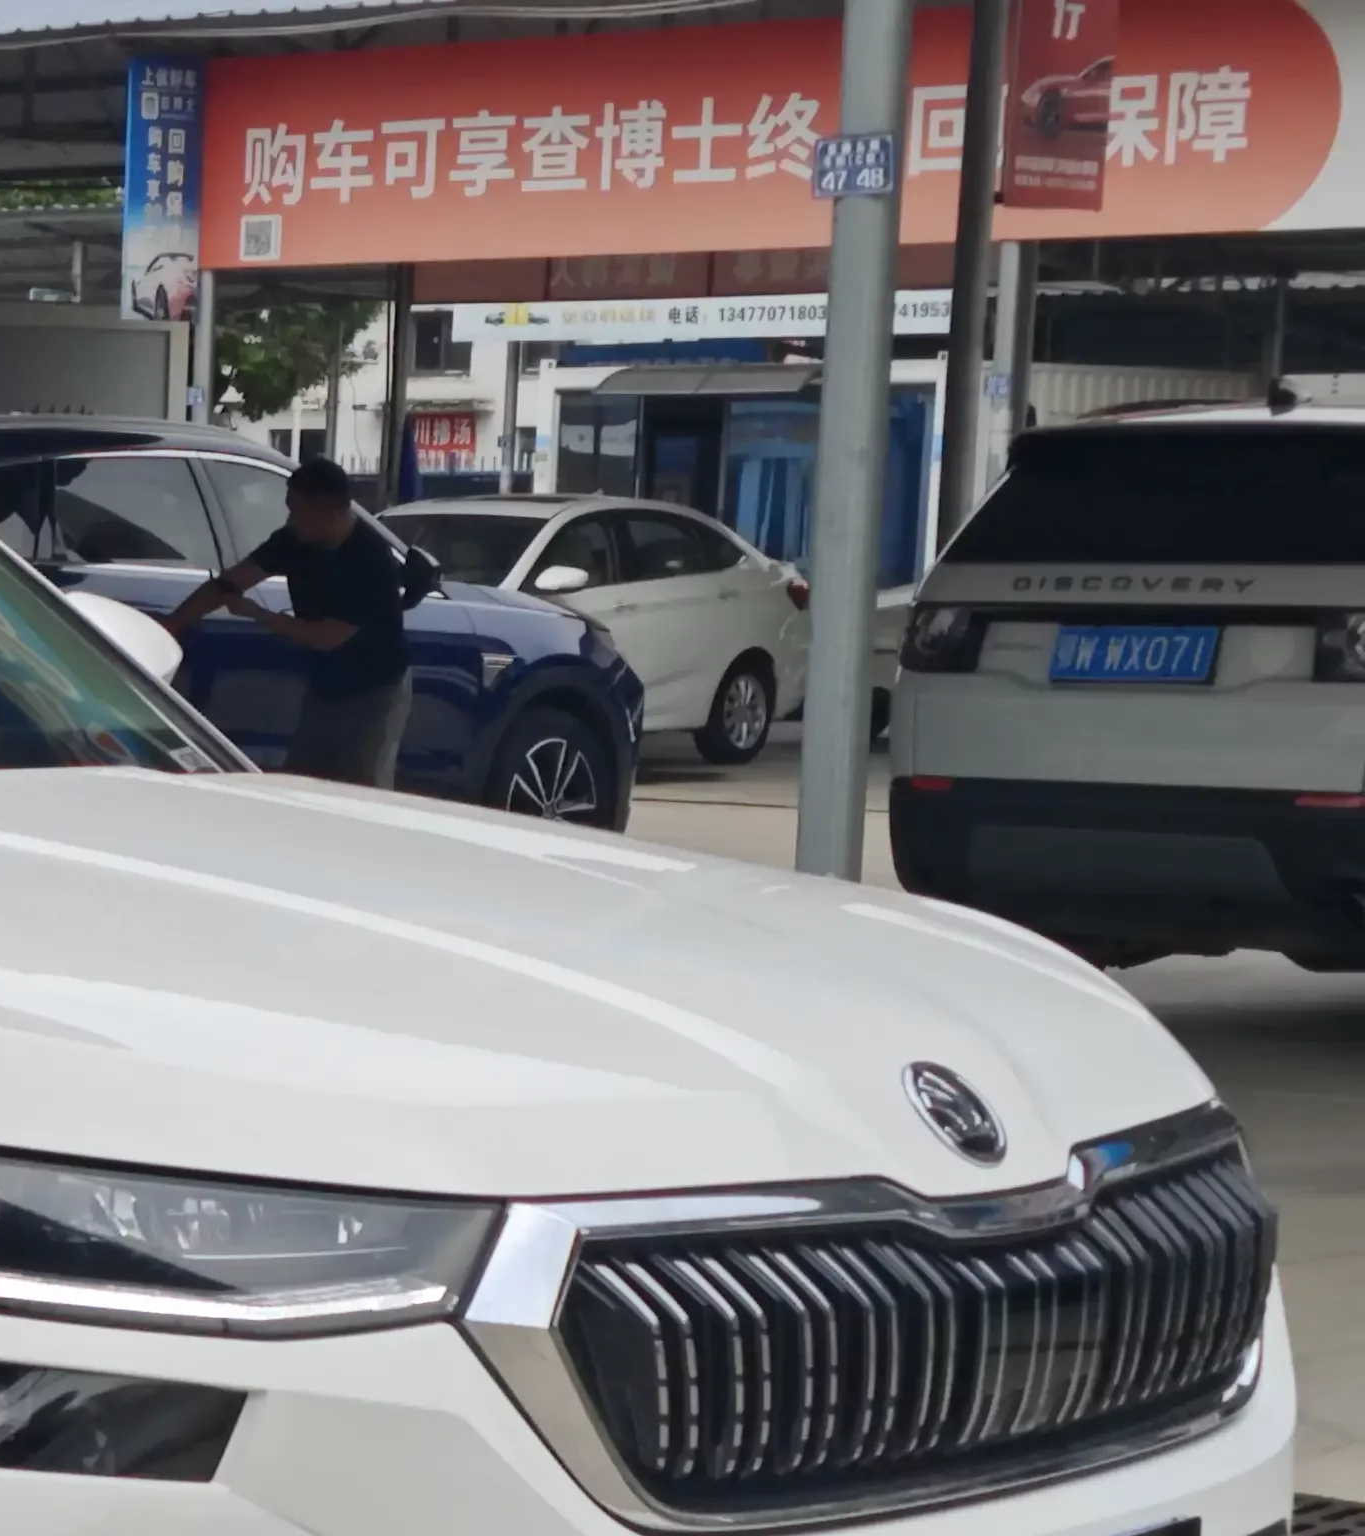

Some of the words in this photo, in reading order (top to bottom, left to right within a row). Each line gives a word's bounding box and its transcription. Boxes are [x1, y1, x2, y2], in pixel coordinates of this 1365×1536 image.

[242, 66, 1252, 206] 购车可享查博士终回保障
[820, 170, 848, 193] 47
[856, 167, 885, 188] 48
[893, 302, 950, 318] 41953
[1012, 574, 1256, 593] DISCOVERY
